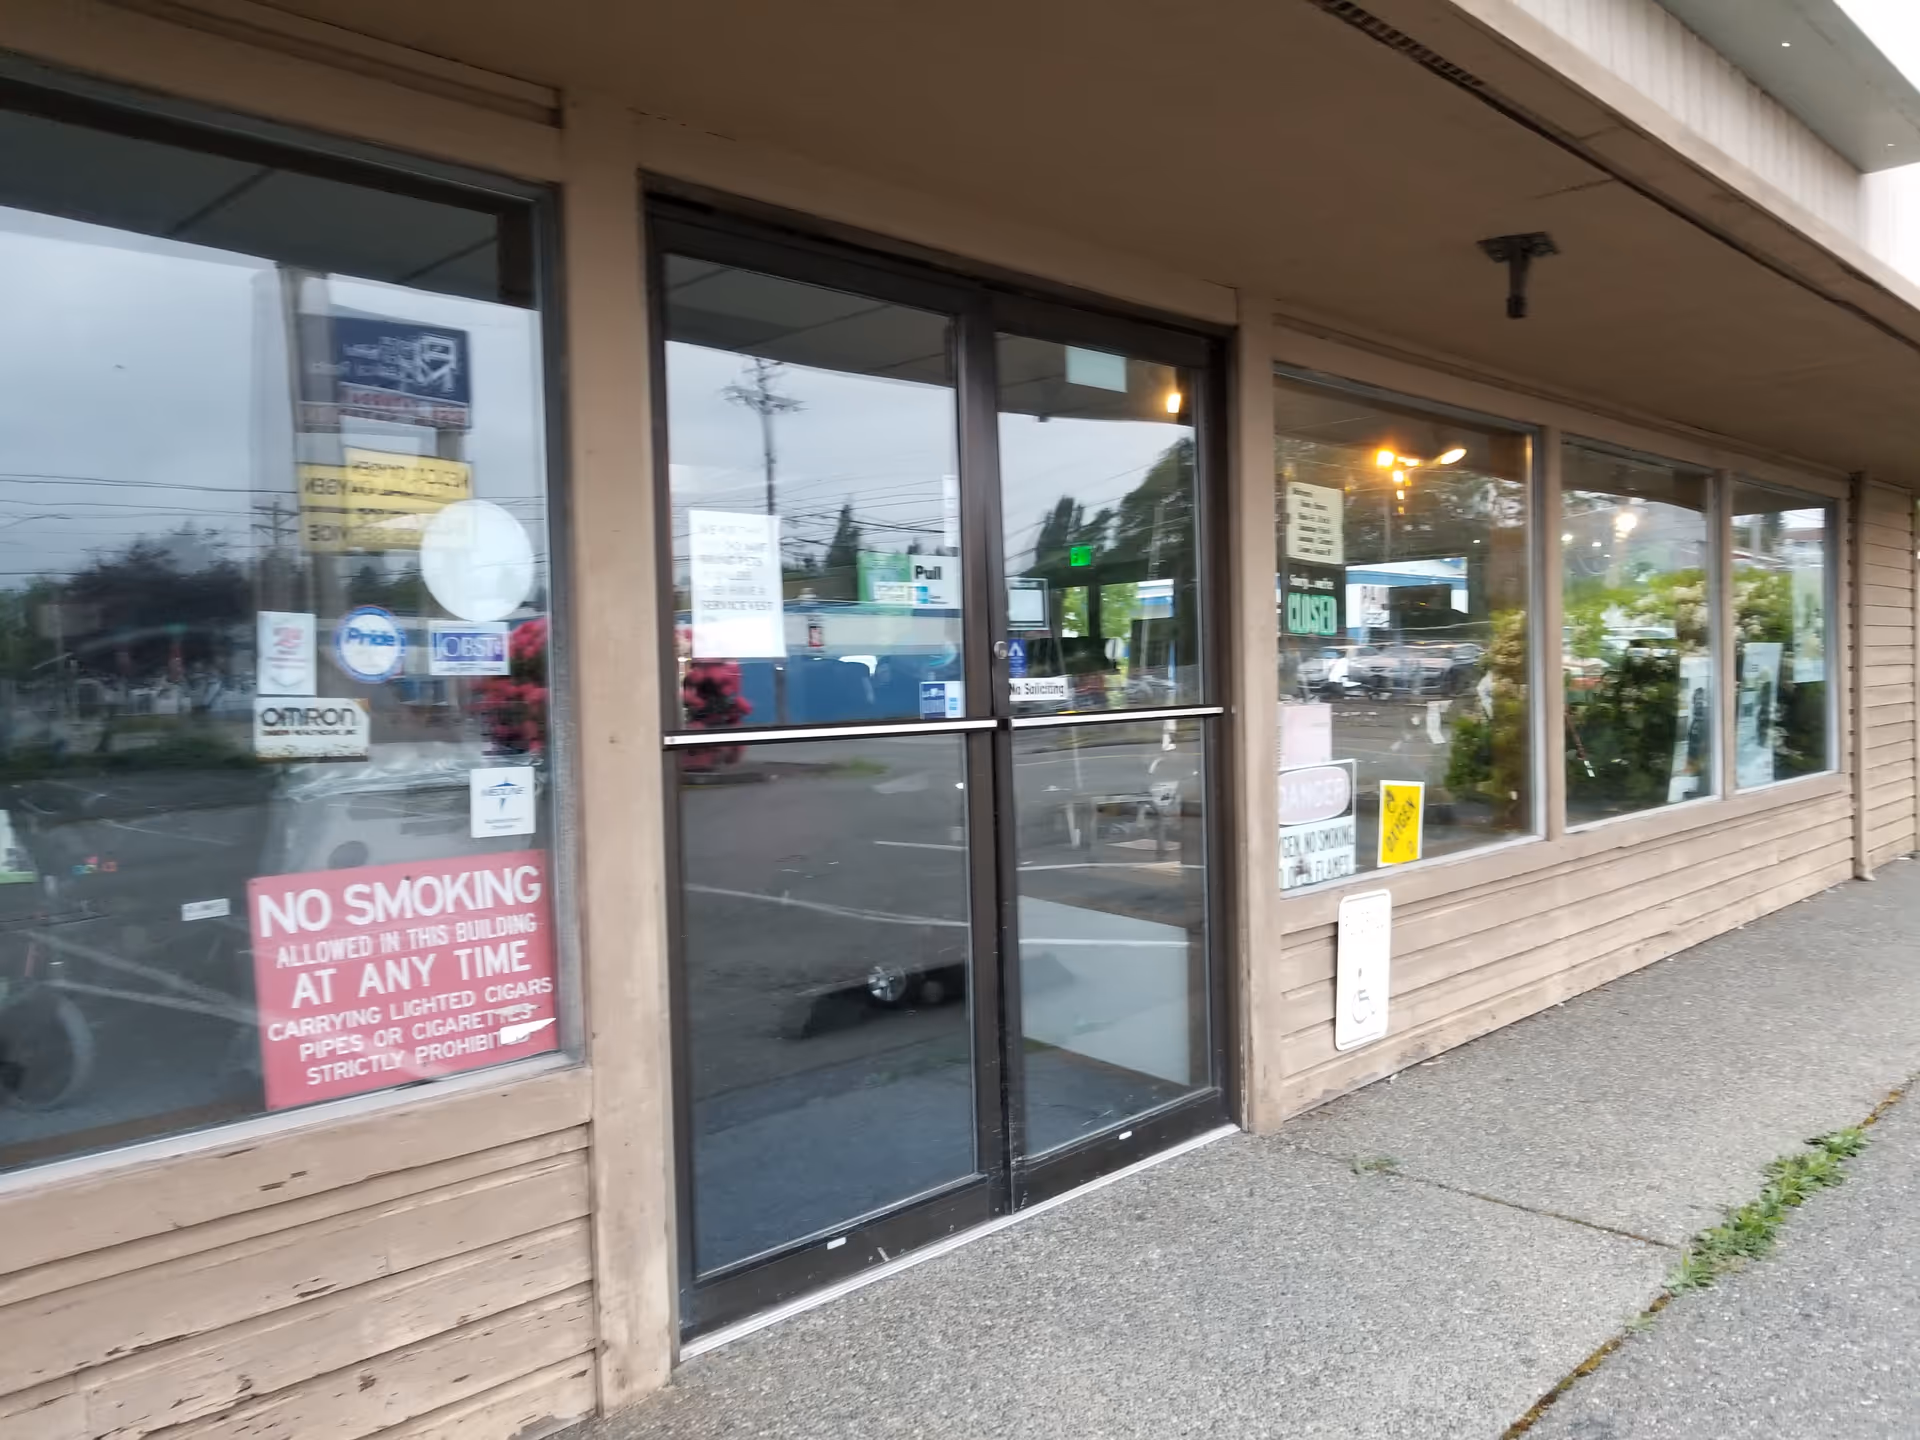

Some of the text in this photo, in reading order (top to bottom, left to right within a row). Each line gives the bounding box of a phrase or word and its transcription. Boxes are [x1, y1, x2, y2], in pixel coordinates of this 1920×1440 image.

[915, 565, 942, 580] Pull
[258, 865, 542, 938] NO SMOKING
[276, 913, 537, 968] ALLOWED IN THIS BUILDING
[291, 940, 532, 1008] AT ANY TIME
[267, 977, 554, 1041] CARRYING LIGHTED CIGARS
[299, 1033, 365, 1062] PIPES
[373, 1026, 404, 1048] OR
[306, 1030, 531, 1086] STRICTLY PROHIBIT
